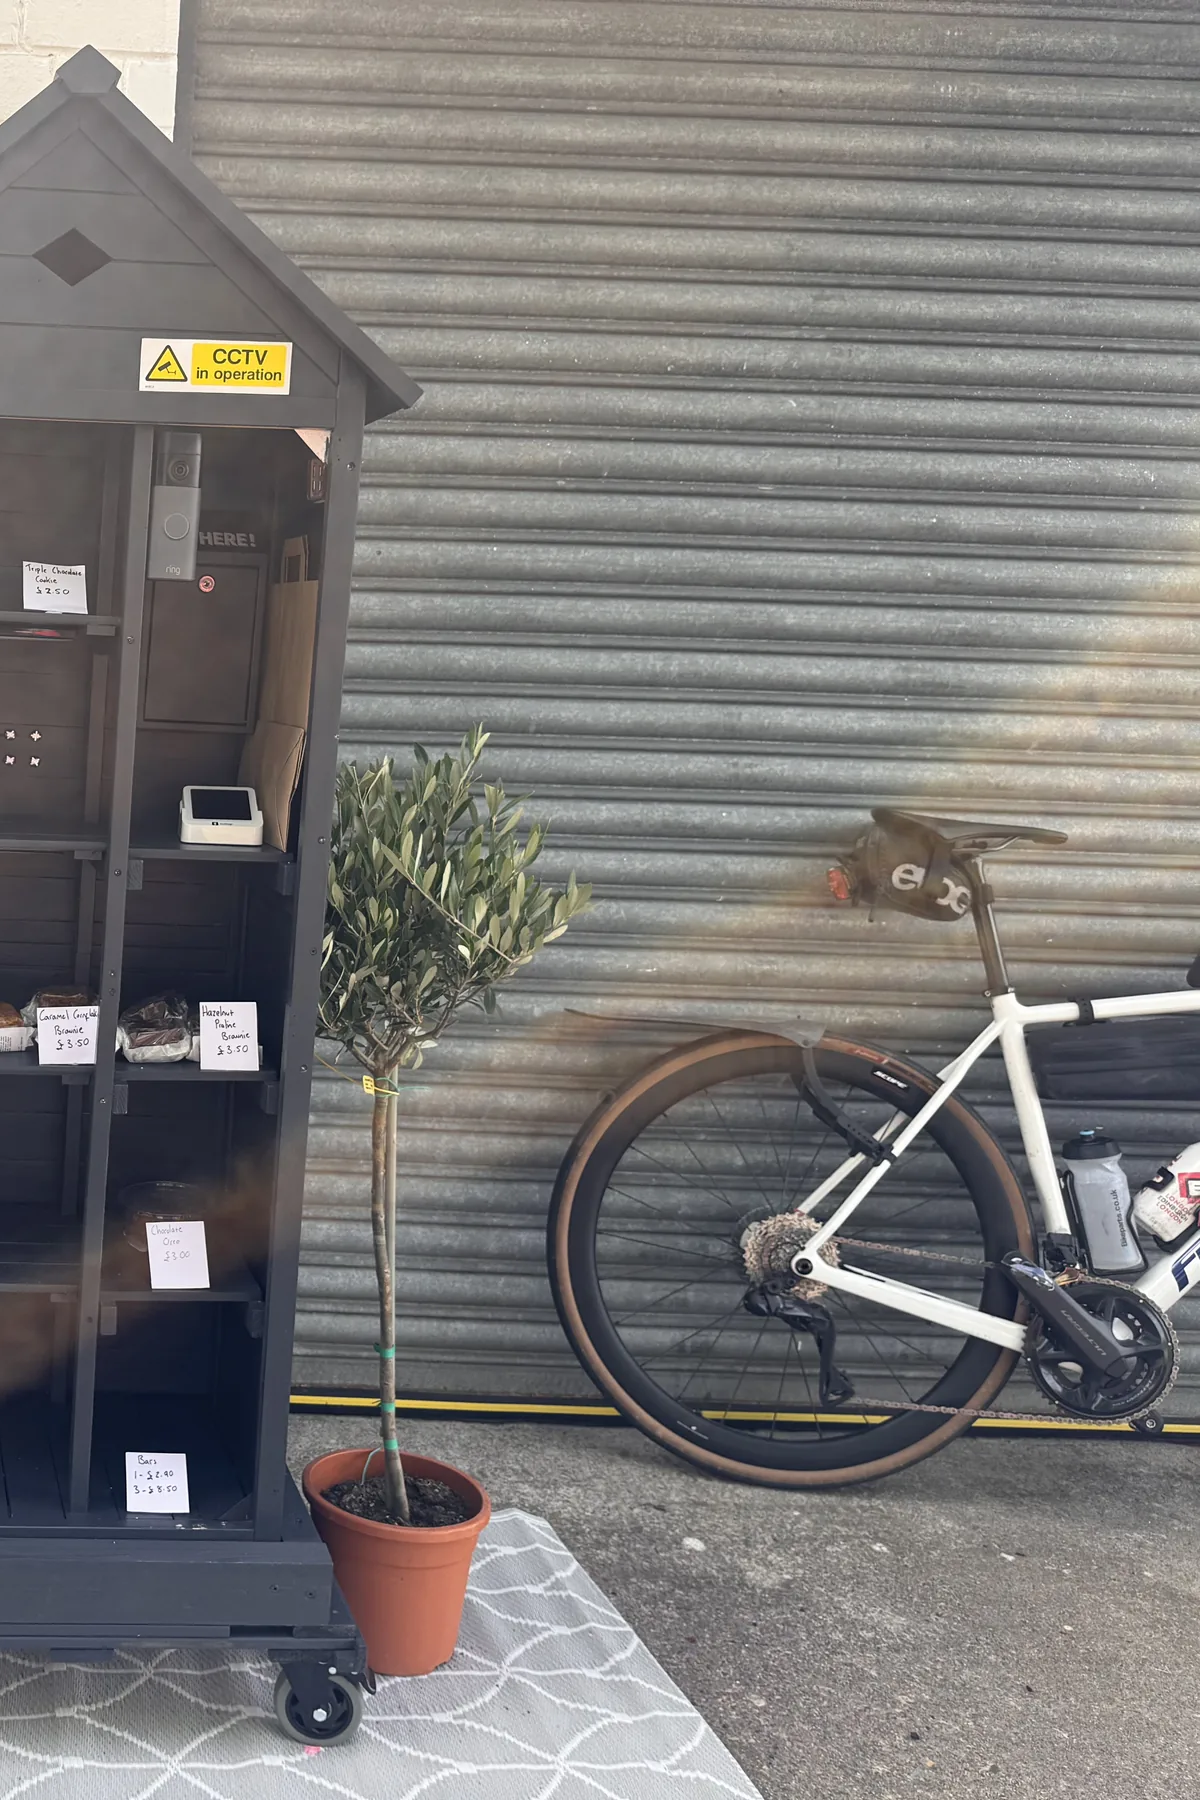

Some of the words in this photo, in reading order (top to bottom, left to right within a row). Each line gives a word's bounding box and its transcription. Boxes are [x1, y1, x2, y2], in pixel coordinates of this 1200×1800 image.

[212, 348, 268, 366] CCTV
[196, 367, 208, 379] in
[214, 368, 282, 382] operation
[199, 532, 256, 548] HERE!
[25, 564, 47, 574] Triple
[166, 564, 180, 575] ring
[35, 576, 58, 584] Cookie
[36, 586, 70, 595] £2.50
[40, 1009, 69, 1021] Caramel
[202, 1005, 234, 1017] Hazelnut
[54, 1025, 84, 1036] Brownie
[215, 1020, 236, 1030] Praline
[222, 1030, 250, 1040] Brownie
[56, 1038, 90, 1050] £3.50
[217, 1045, 249, 1055] £3.50
[1157, 1195, 1188, 1222] EDINBURGH
[1165, 1193, 1192, 1216] LONDON
[1110, 1189, 1128, 1247] Bikeparts.co.uk
[1156, 1202, 1182, 1224] LONDON
[151, 1224, 183, 1235] Chocolate
[163, 1237, 180, 1246] Oreo
[164, 1250, 190, 1262] £3.00
[138, 1454, 157, 1465] Bars
